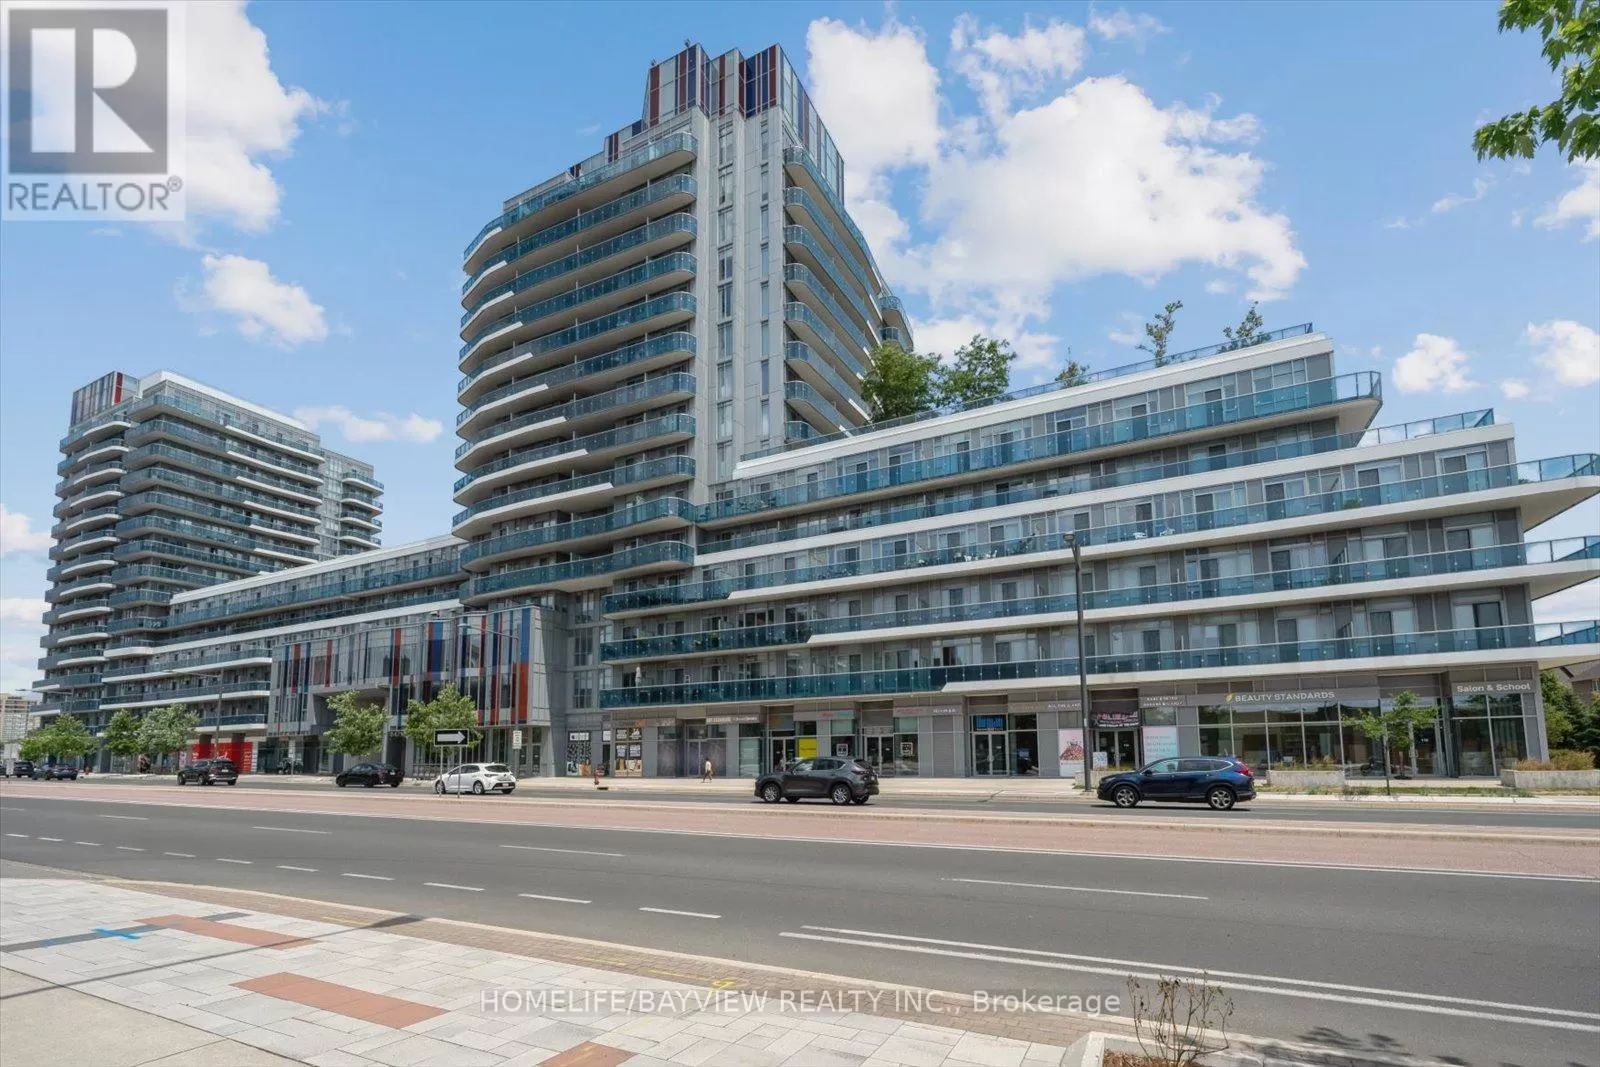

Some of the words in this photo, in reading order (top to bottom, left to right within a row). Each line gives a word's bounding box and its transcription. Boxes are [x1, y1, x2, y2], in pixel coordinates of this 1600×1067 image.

[1496, 682, 1531, 691] School
[1235, 694, 1272, 702] BEAUTY
[1275, 691, 1335, 701] STANDARDS
